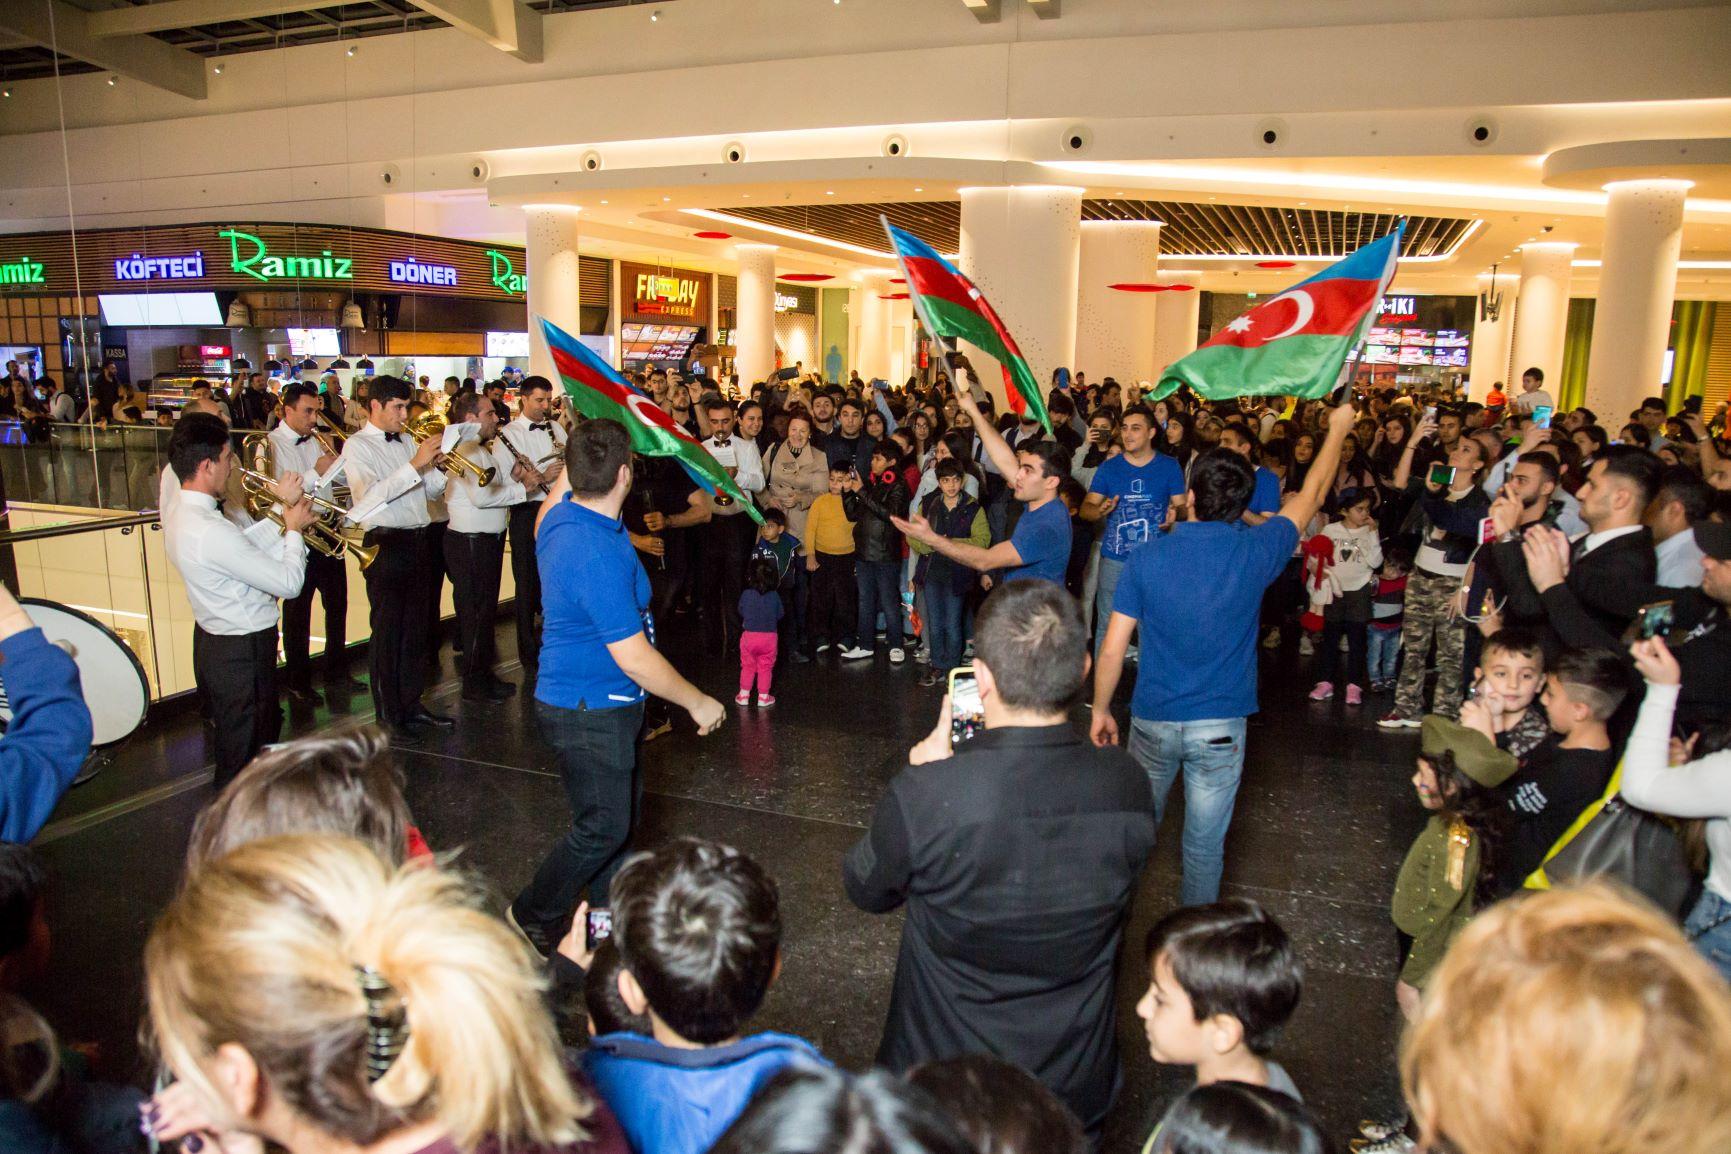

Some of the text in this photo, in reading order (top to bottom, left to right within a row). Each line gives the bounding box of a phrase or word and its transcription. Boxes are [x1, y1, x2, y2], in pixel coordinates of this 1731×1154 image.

[0, 256, 45, 284] miz
[115, 250, 205, 281] KÖFTECİ
[219, 229, 353, 282] Ramiz
[391, 257, 458, 286] DÖNER
[105, 348, 127, 359] KASSA
